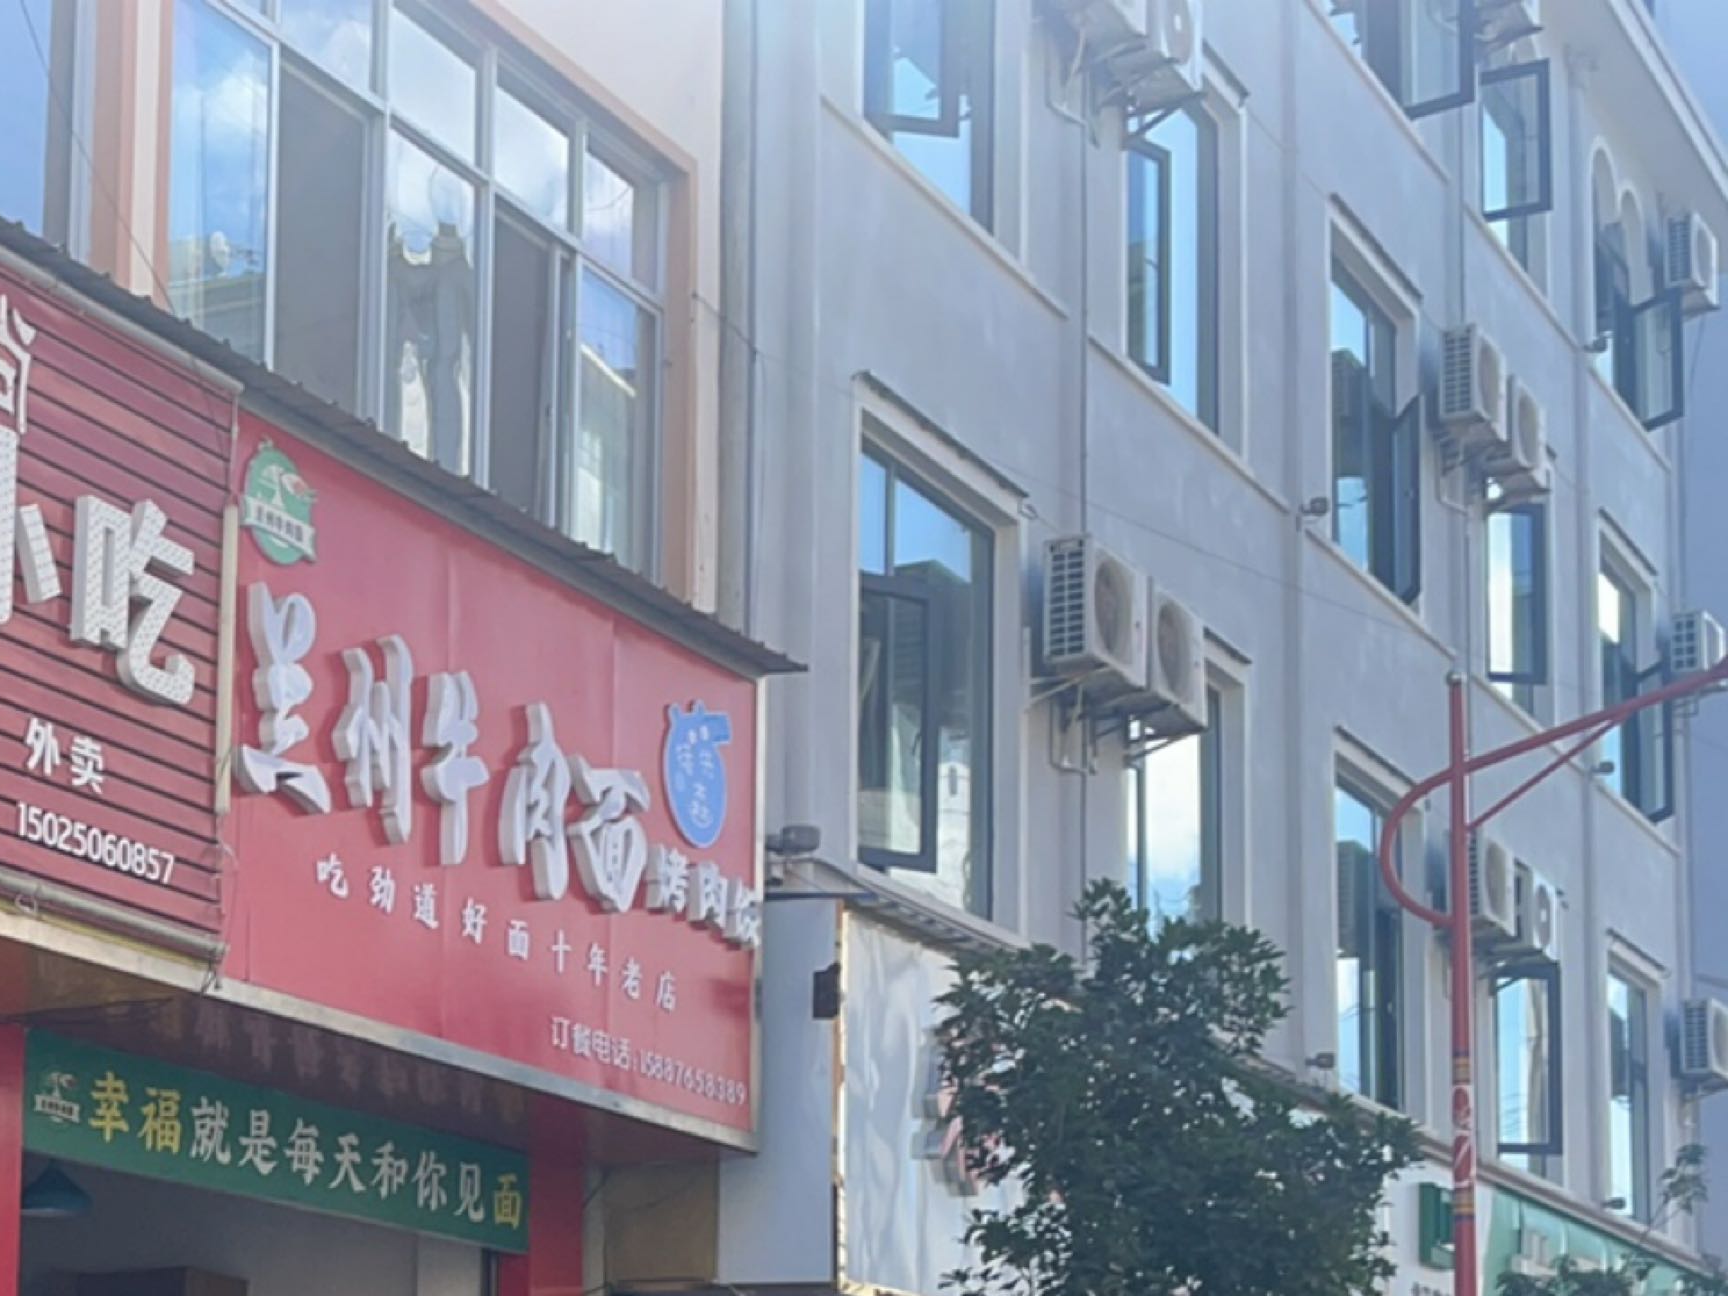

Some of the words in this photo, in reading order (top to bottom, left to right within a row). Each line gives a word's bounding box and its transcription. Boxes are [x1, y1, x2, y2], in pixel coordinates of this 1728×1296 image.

[25, 717, 104, 794] 外卖
[232, 579, 650, 914] 兰州牛肉面
[17, 800, 175, 885] 15025060857
[87, 1071, 524, 1231] 幸福就是每天和你见面
